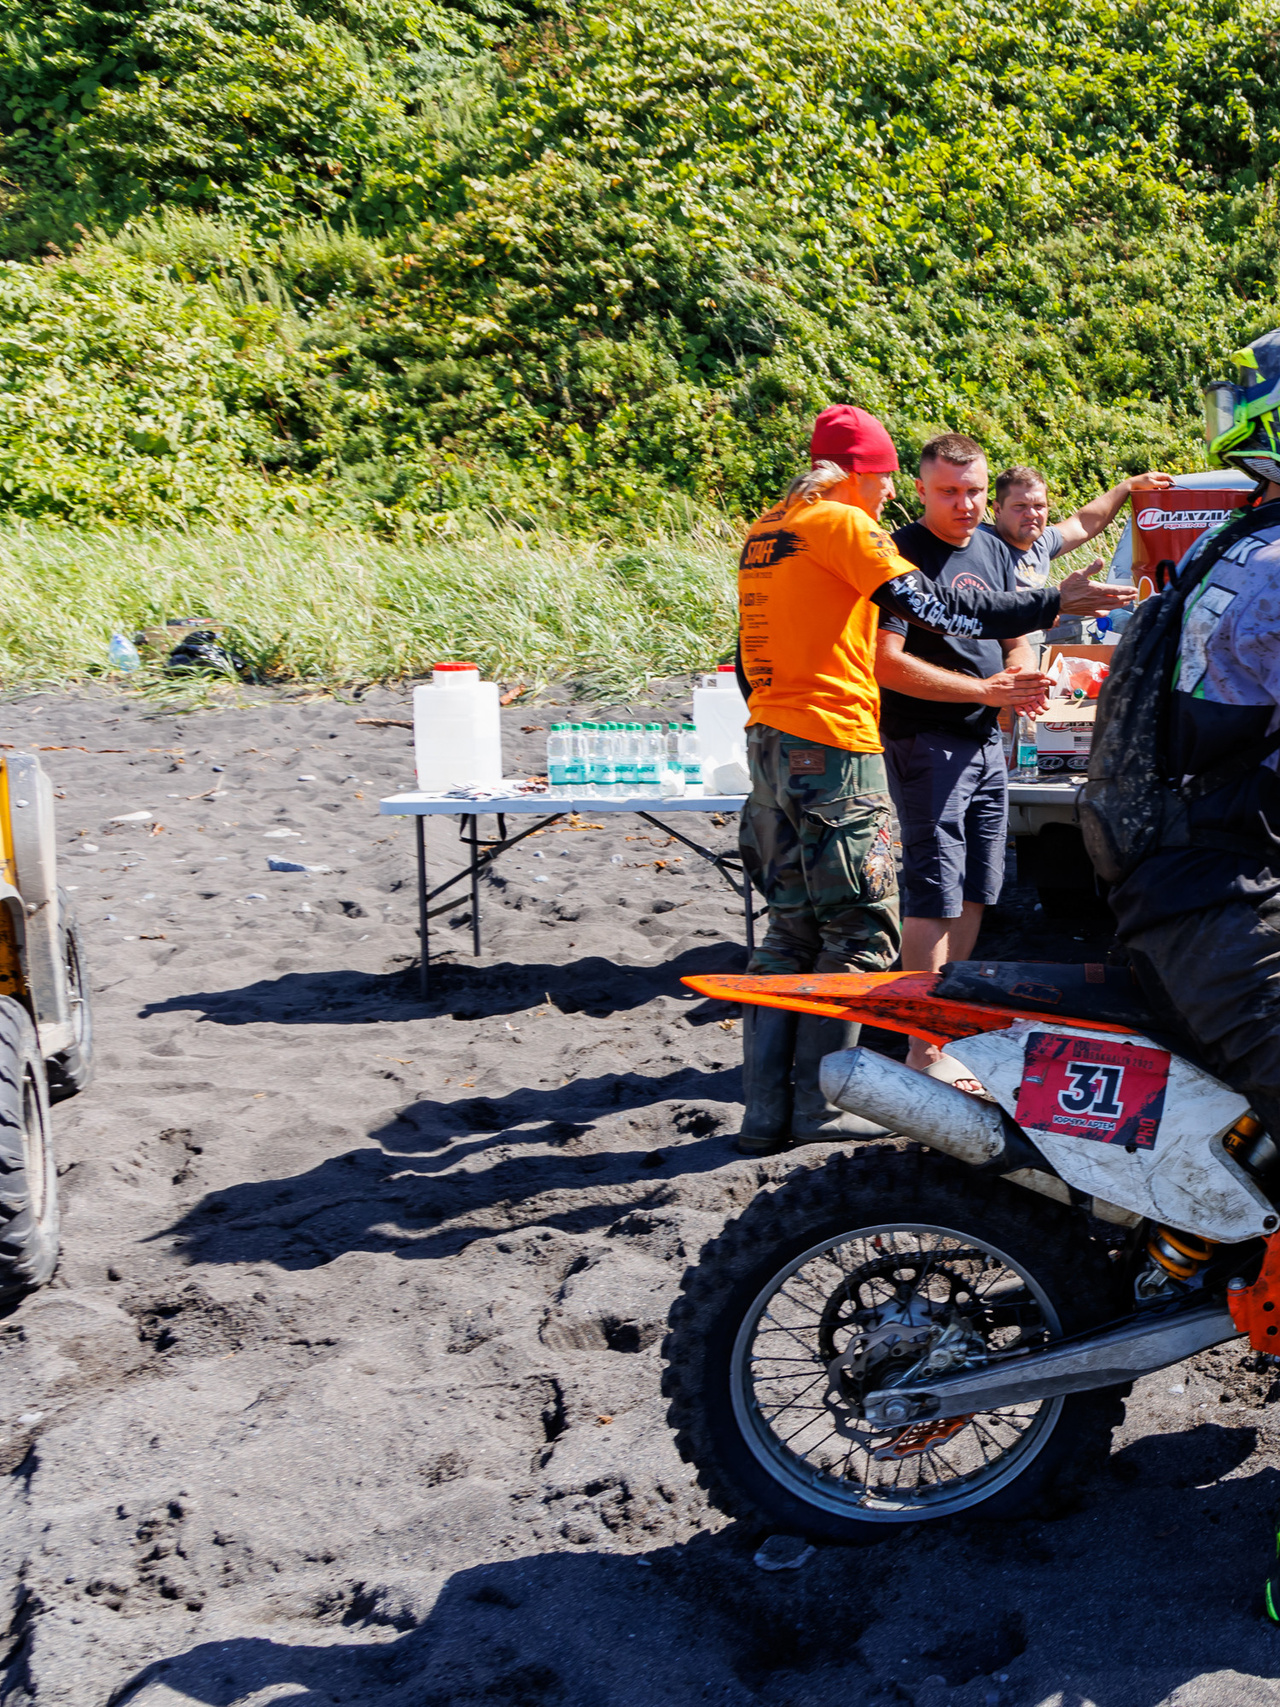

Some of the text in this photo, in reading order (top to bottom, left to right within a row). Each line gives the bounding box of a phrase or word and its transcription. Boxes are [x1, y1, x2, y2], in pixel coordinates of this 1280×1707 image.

[745, 538, 778, 565] STAFF
[1058, 1061, 1125, 1118] 31
[1135, 1117, 1157, 1146] PRO
